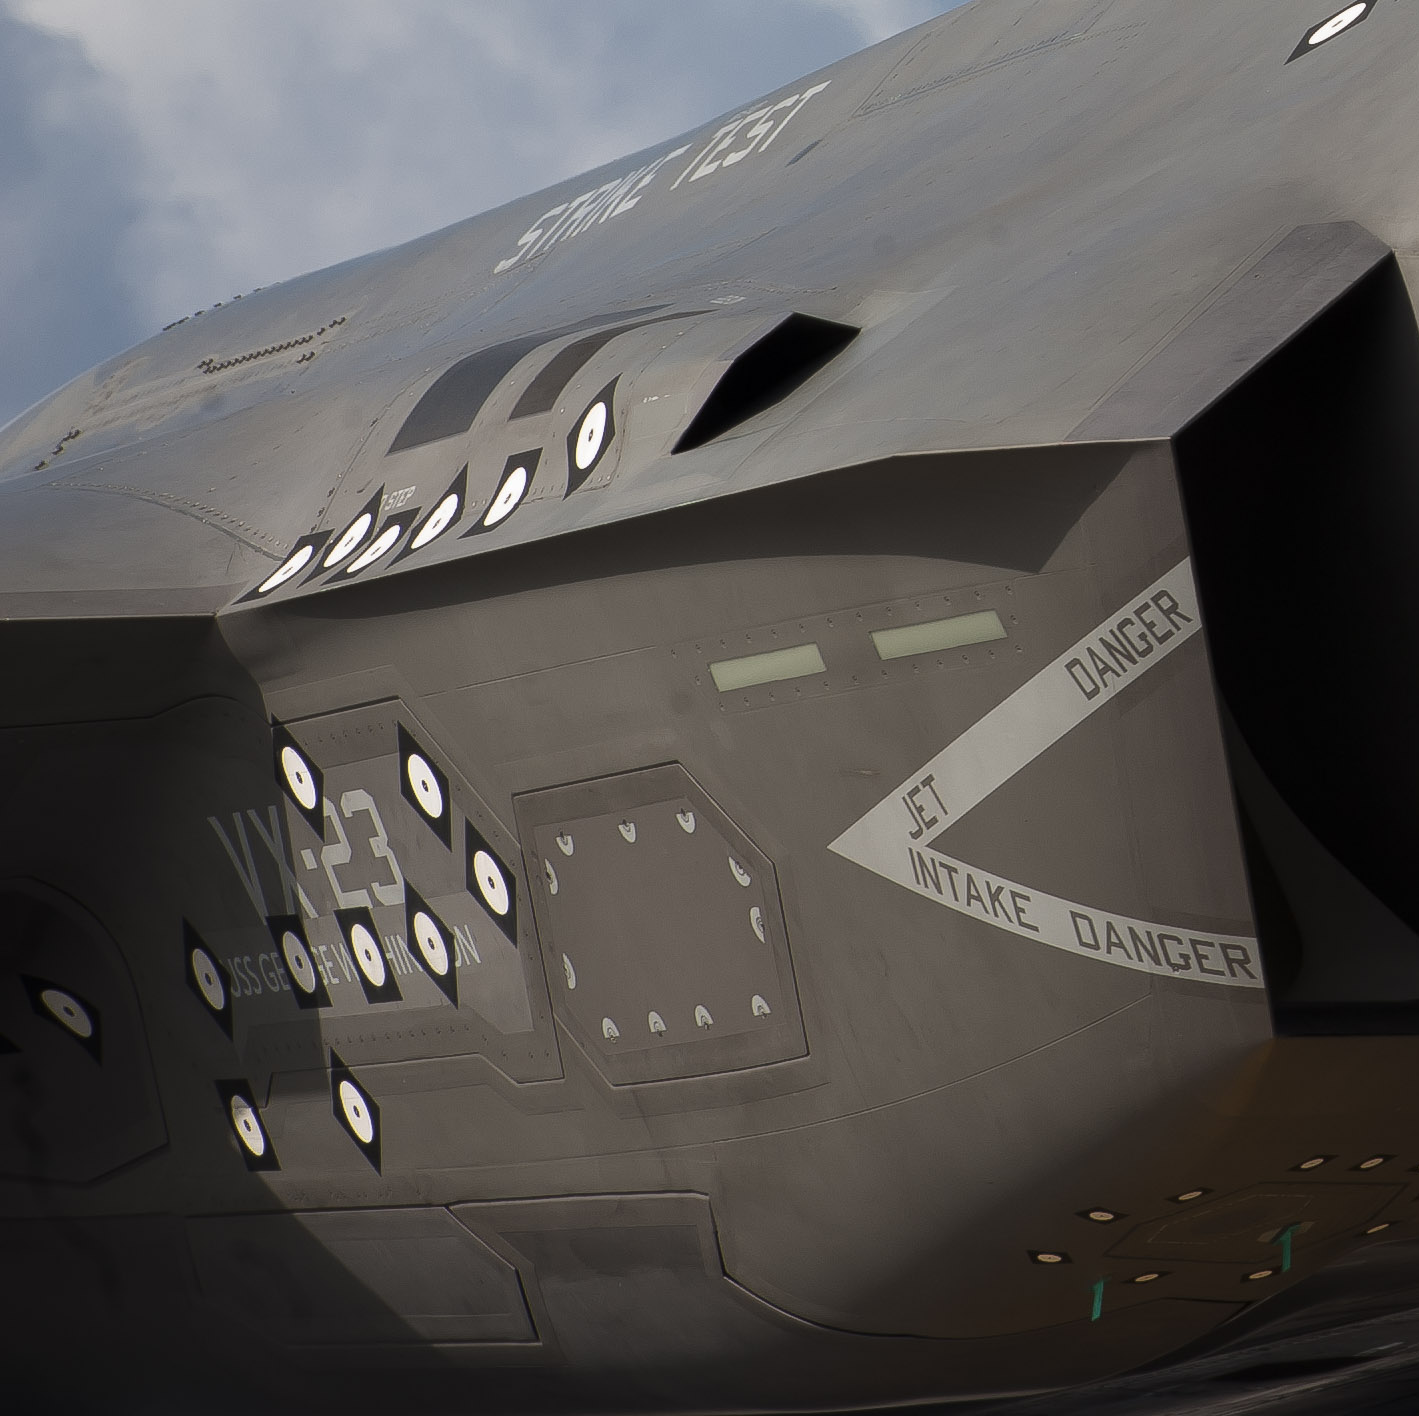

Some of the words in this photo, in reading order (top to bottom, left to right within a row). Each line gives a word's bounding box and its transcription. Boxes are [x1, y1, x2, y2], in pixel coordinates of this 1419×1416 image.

[494, 142, 694, 275] STRIKE
[670, 79, 833, 192] TEST
[901, 773, 948, 840] JET
[1065, 589, 1194, 702] DANGER
[908, 847, 1040, 933] INTAKE
[1070, 910, 1258, 980] DANGER
